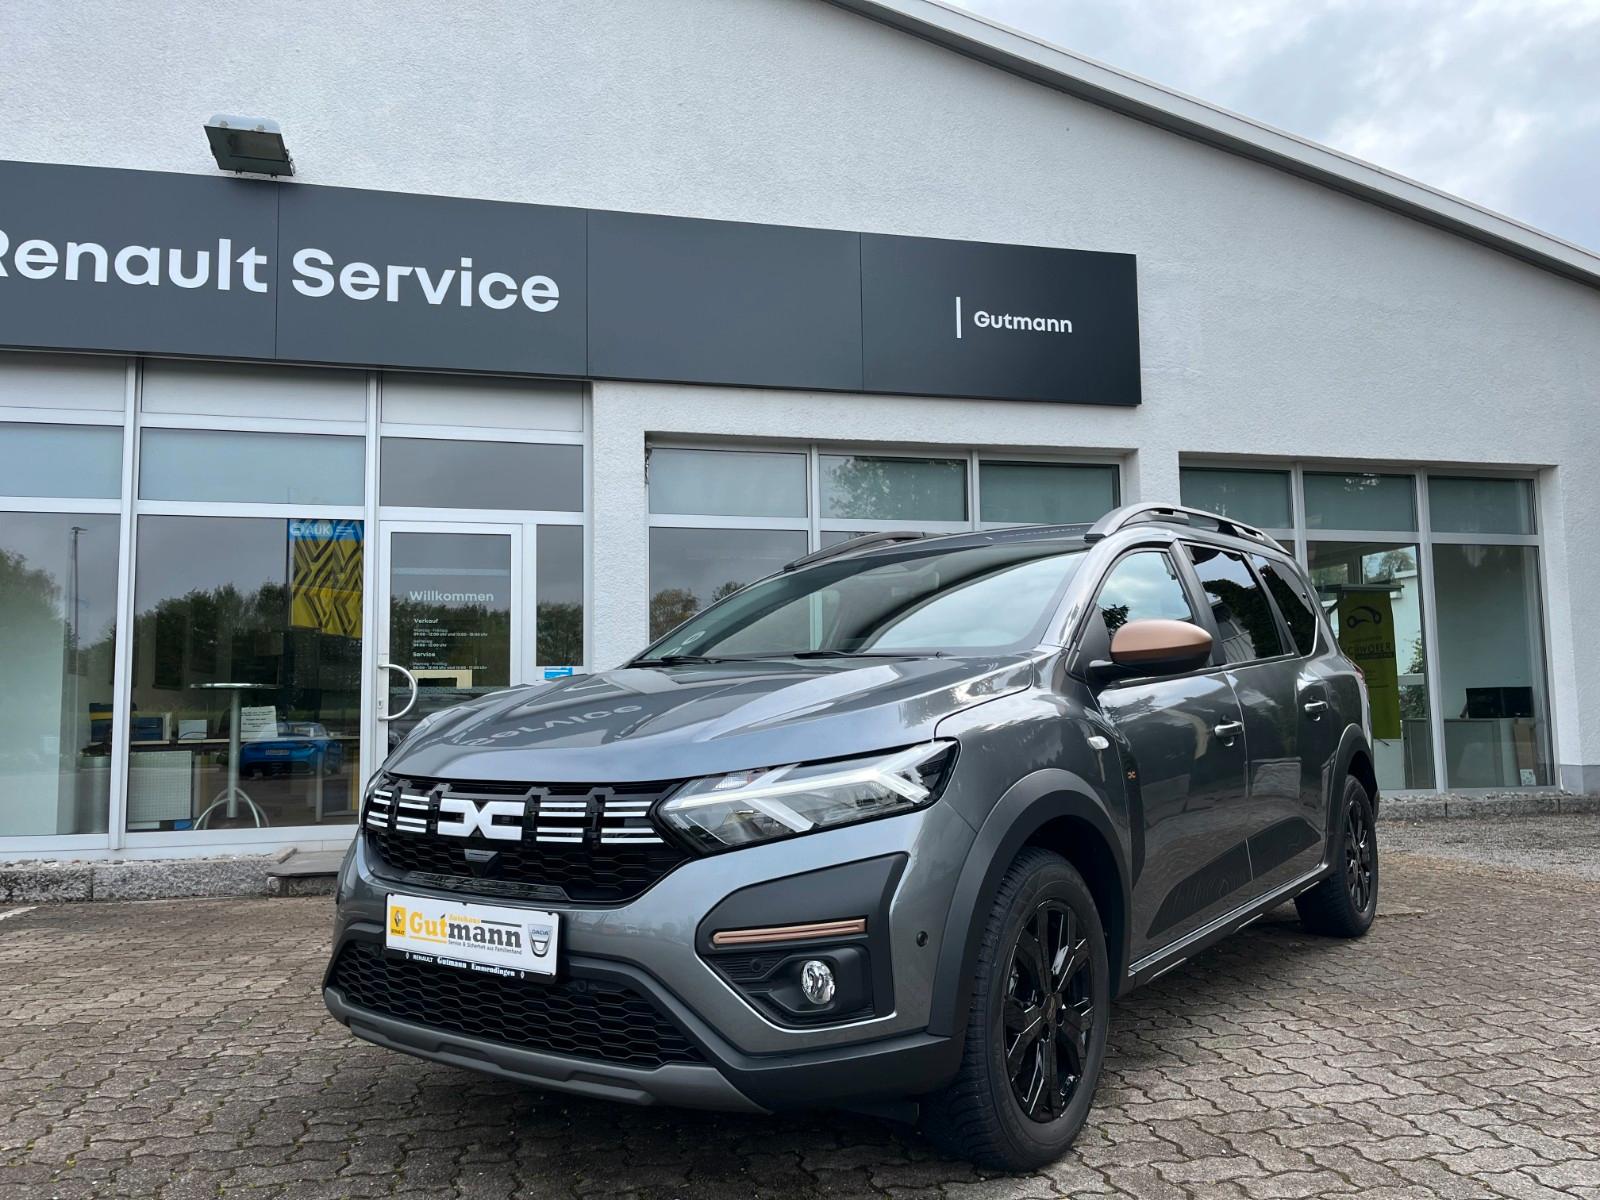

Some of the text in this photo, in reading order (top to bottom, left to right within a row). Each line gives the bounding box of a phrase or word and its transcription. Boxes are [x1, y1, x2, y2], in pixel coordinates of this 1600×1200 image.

[0, 229, 560, 313] enault Service
[974, 311, 1073, 333] Gutmann
[409, 590, 495, 602] Willkommen
[409, 910, 523, 949] Gutmann
[412, 954, 516, 978] RENAULT Gutmann Emmendingen
